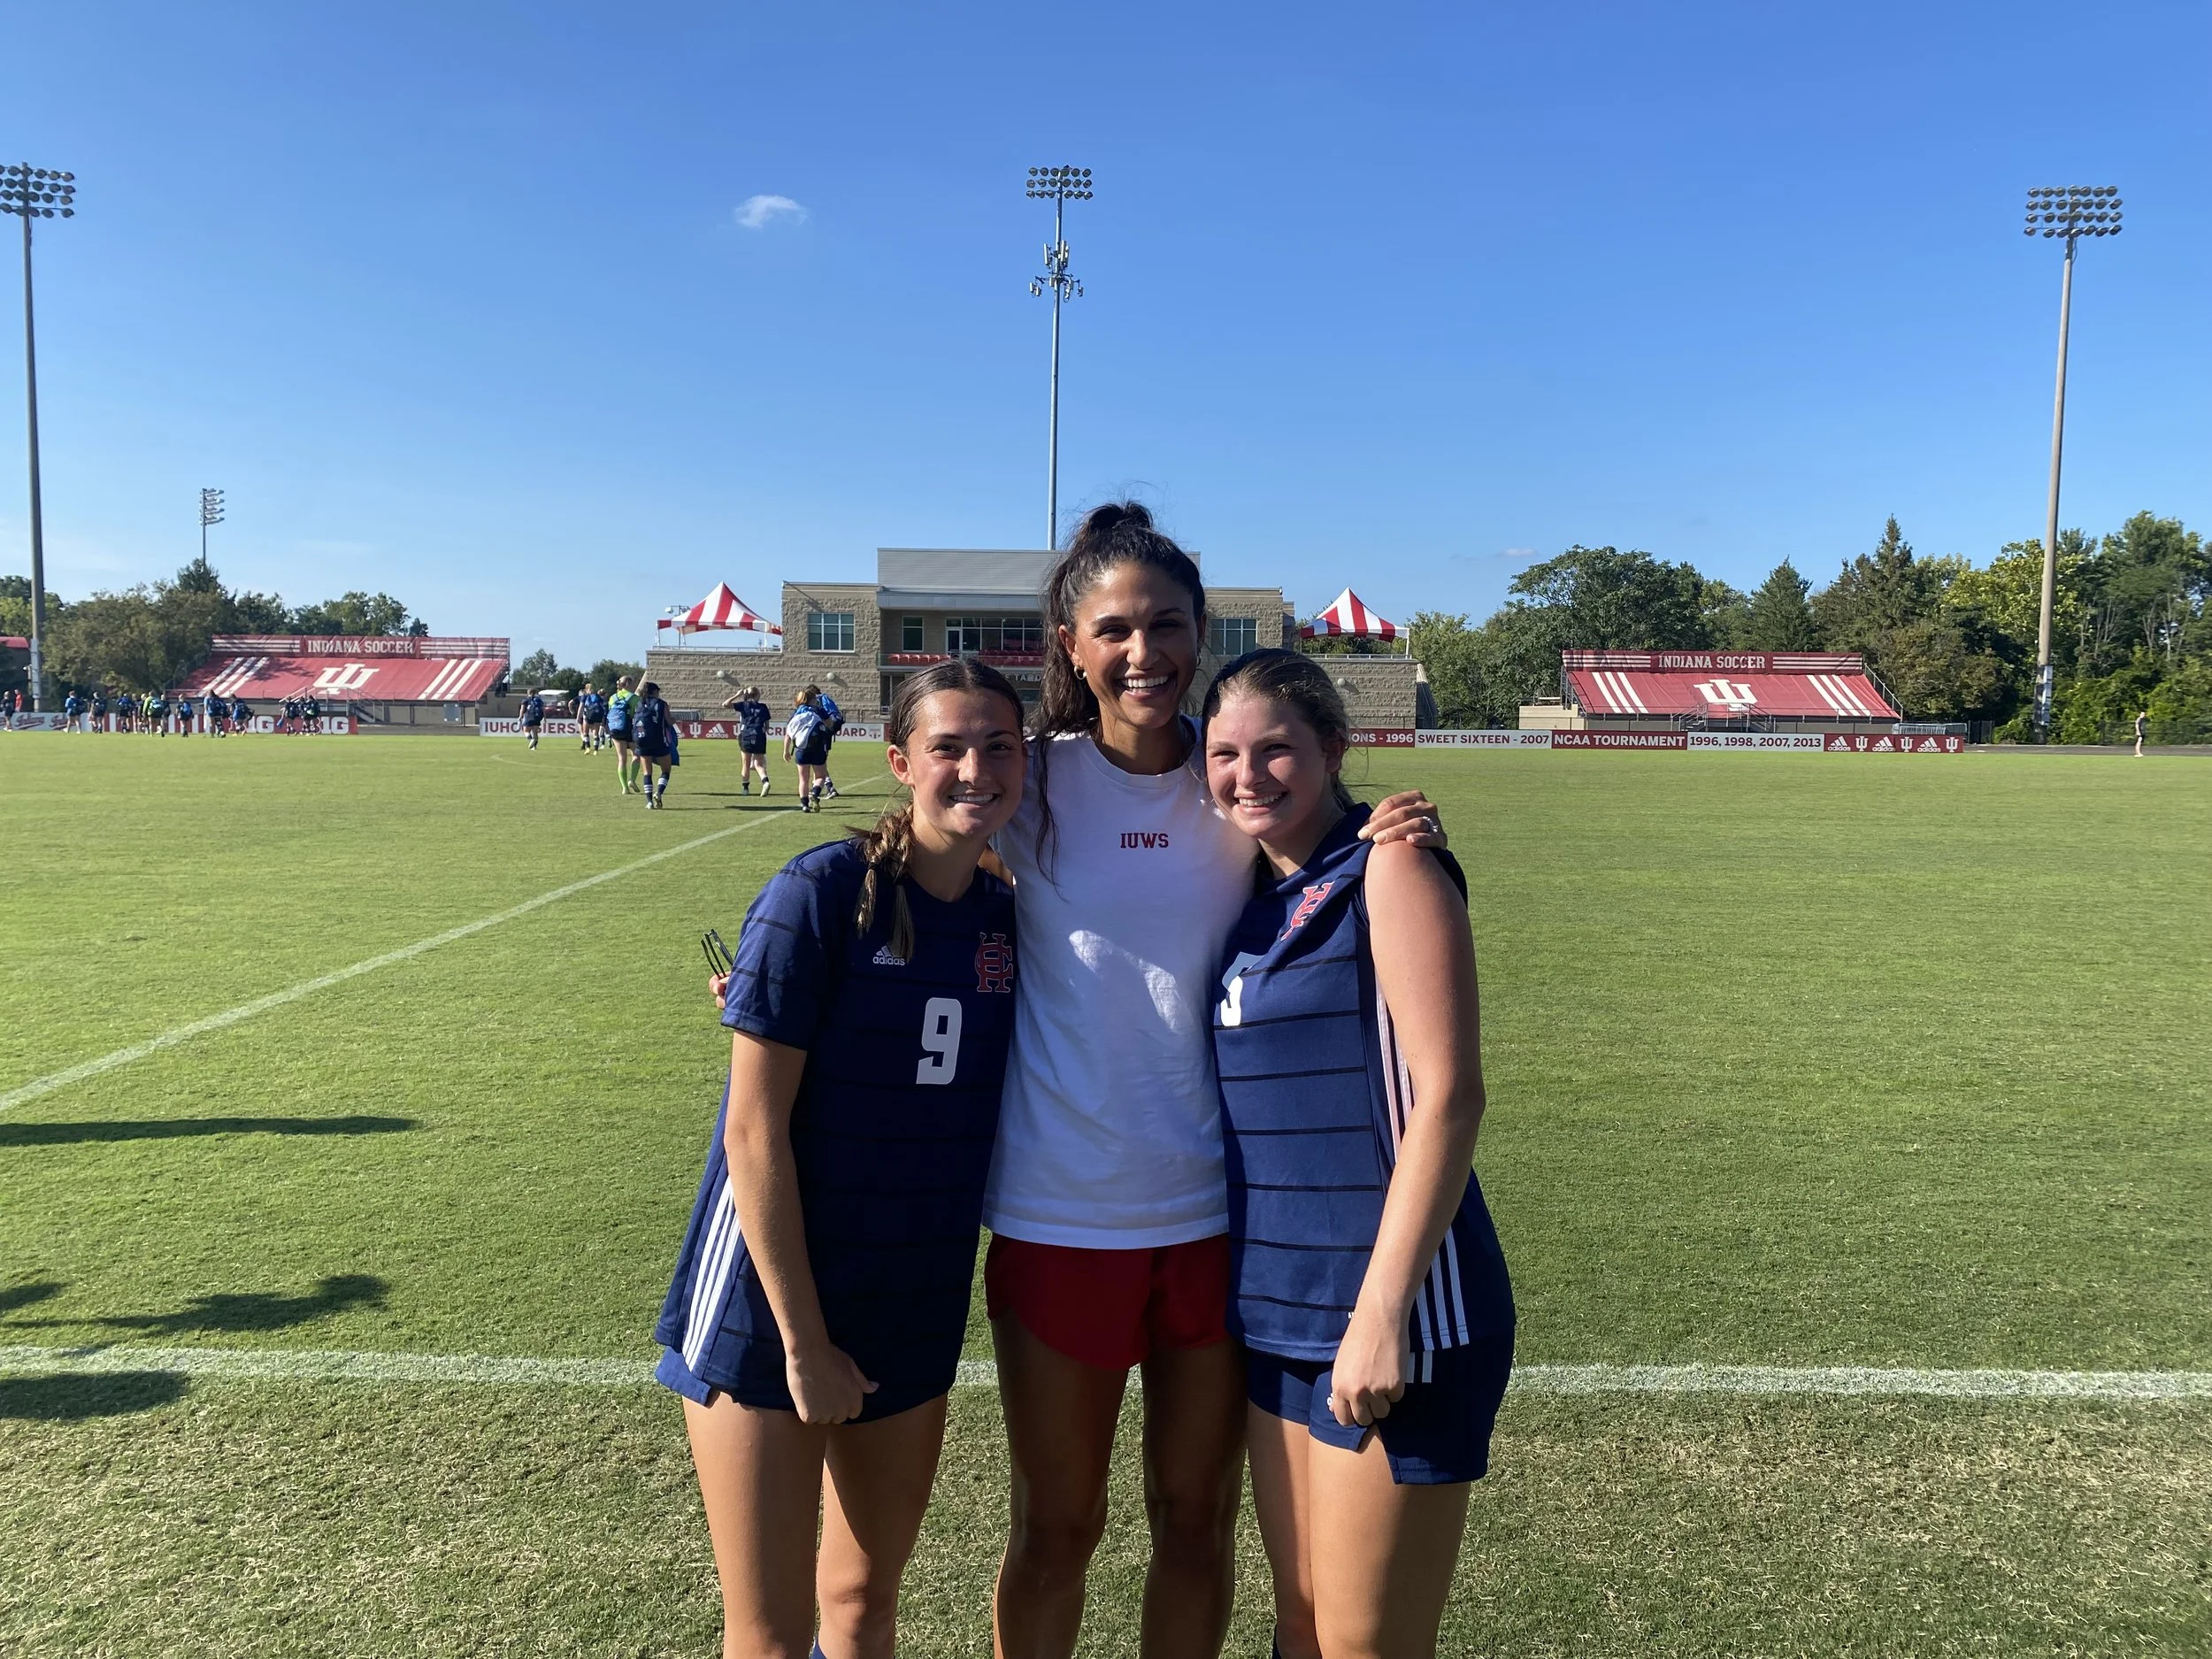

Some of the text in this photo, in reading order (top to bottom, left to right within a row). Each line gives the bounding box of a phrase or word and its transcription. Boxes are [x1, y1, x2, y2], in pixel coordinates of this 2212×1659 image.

[307, 640, 413, 654] INDIANA SOCCER
[1658, 655, 1766, 669] INDIANA SOCCER
[834, 727, 867, 737] UARD
[1386, 733, 1414, 743] 1996
[1417, 734, 1457, 744] SWEET
[1460, 734, 1510, 744] SIXTEEN
[1520, 734, 1549, 744] 2007
[1554, 734, 1686, 747] NCAA TOURNAMENT
[1690, 736, 1822, 749] 1996, 1998, 2007, 2013
[1120, 832, 1169, 849] IUWS
[872, 955, 906, 966] adidas
[915, 996, 963, 1085] 9
